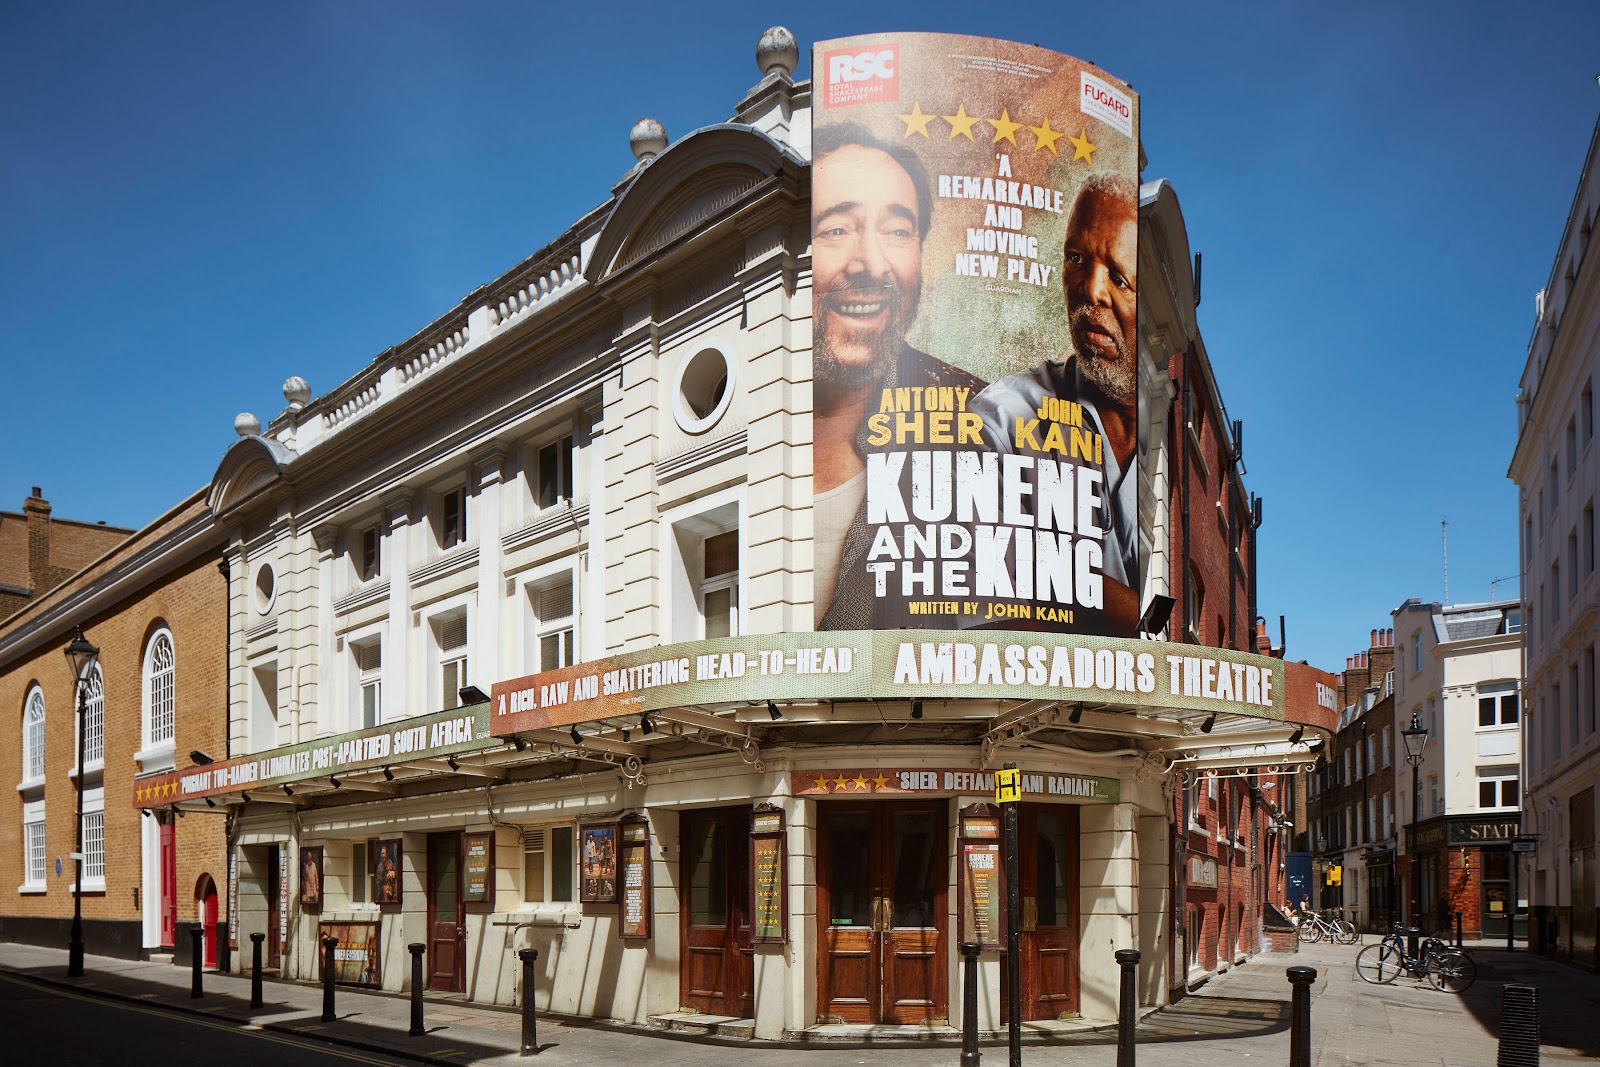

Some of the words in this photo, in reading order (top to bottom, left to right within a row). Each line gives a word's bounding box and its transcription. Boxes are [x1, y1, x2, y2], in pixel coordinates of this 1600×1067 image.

[830, 49, 895, 85] RSC
[829, 82, 854, 91] ROYAL
[829, 85, 883, 98] SHAKESPEARE
[829, 93, 868, 104] COMPANY
[1084, 83, 1129, 118] FUGARD
[938, 174, 1064, 215] REMARKABLE
[983, 203, 1023, 231] AND
[966, 227, 1038, 260] MOVING
[955, 253, 999, 278] NEW
[985, 284, 1022, 295] GUARDIAN
[879, 386, 971, 413] ANTONY
[1037, 395, 1083, 427] JOHN
[867, 412, 985, 447] SHER
[1014, 416, 1103, 465] KANI
[866, 450, 1103, 540] KUNENE
[866, 524, 973, 561] AND
[866, 560, 971, 598] THE
[974, 525, 1104, 610] KING
[908, 601, 959, 616] WRITTEN
[963, 602, 979, 616] BY
[984, 602, 1031, 620] JOHN
[1036, 605, 1074, 624] KANI
[540, 681, 569, 708] RAW
[573, 675, 599, 702] AND
[602, 657, 690, 696] SHATTERING
[893, 642, 1156, 693] AMBASSADORS
[1166, 654, 1273, 707] THEATRE
[631, 695, 646, 704] TIMES
[213, 761, 258, 789] TWO-HANDER
[259, 751, 310, 781] ILLUMINATES
[312, 733, 391, 770] POST-APARTHEID
[393, 725, 427, 755] SOUTH
[944, 771, 995, 791] DEFIAN
[1021, 774, 1044, 793] ANI
[998, 772, 1017, 799] H
